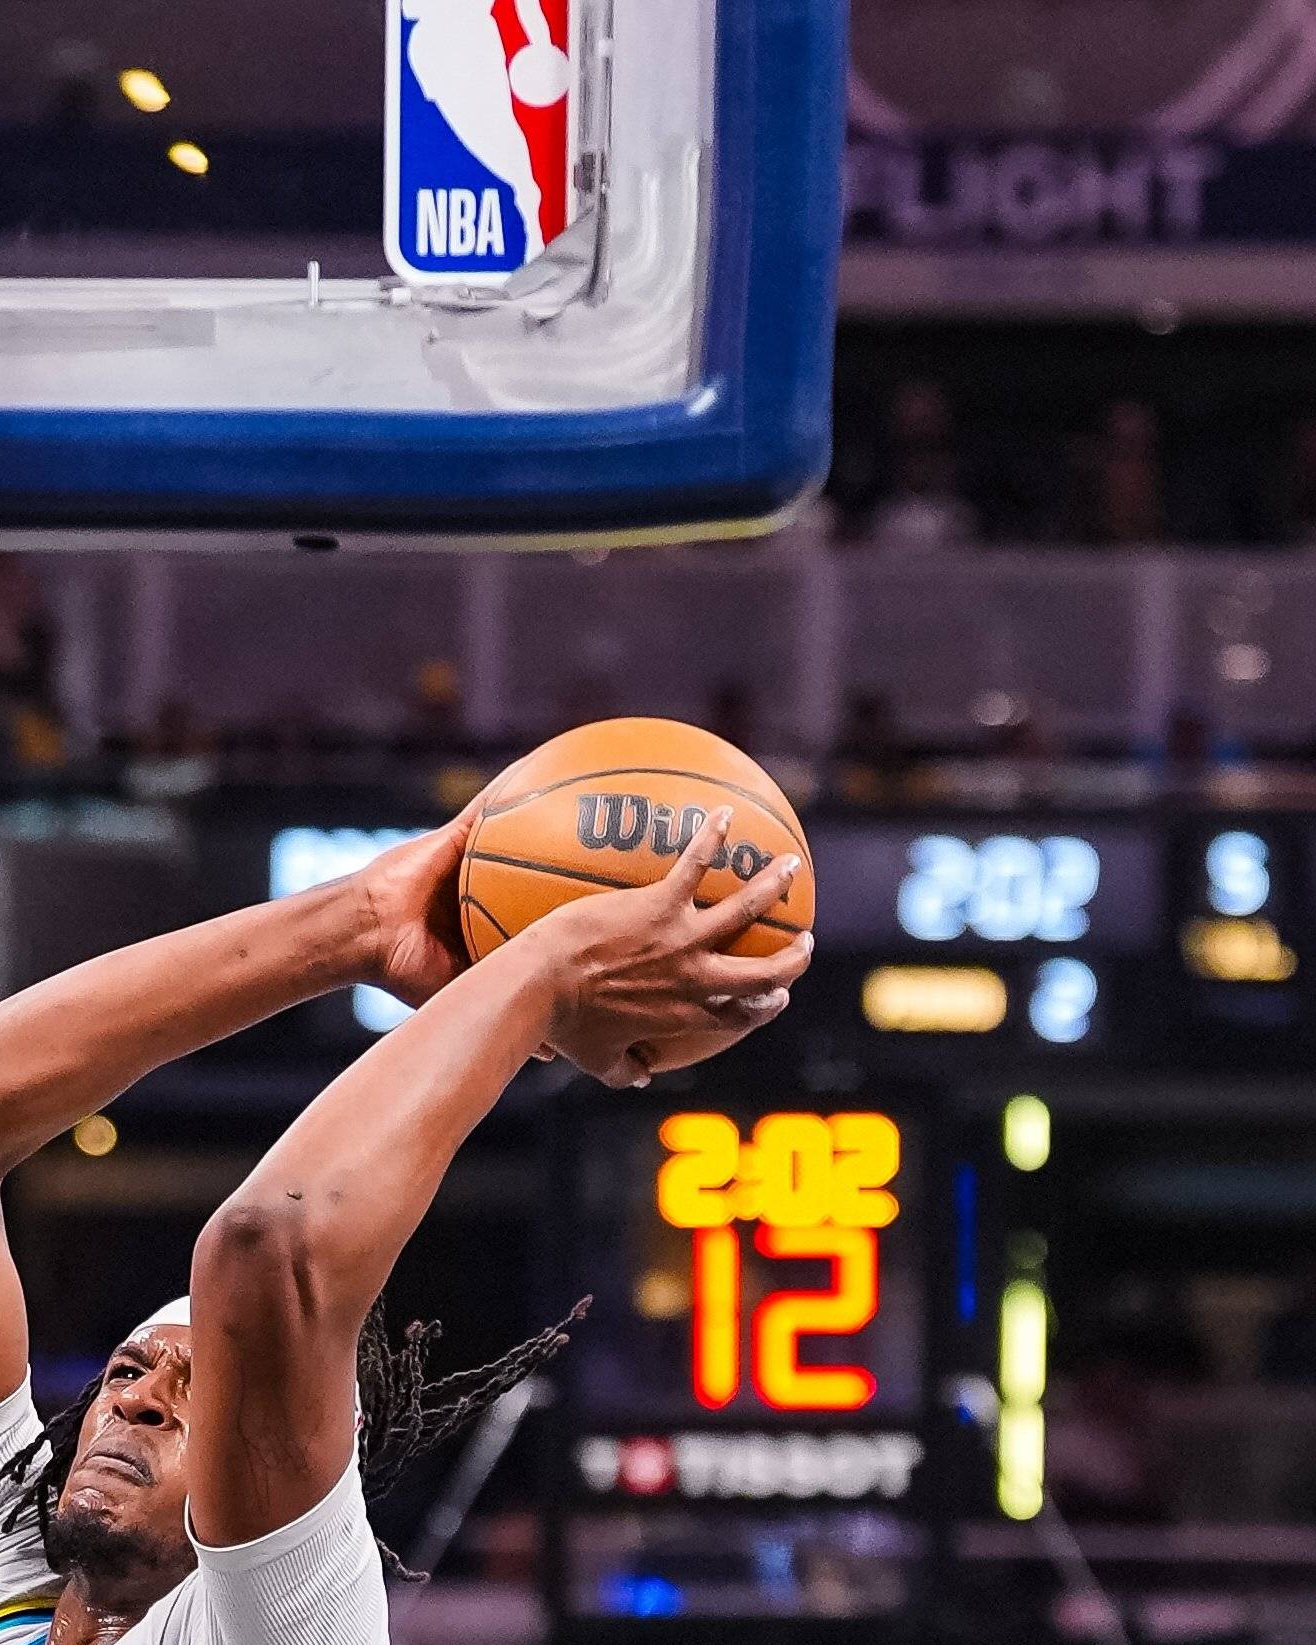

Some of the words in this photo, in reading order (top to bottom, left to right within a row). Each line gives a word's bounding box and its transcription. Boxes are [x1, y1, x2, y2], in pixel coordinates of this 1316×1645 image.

[415, 187, 505, 257] NBA
[656, 1112, 900, 1229] 2:02
[691, 1224, 880, 1411] 12
